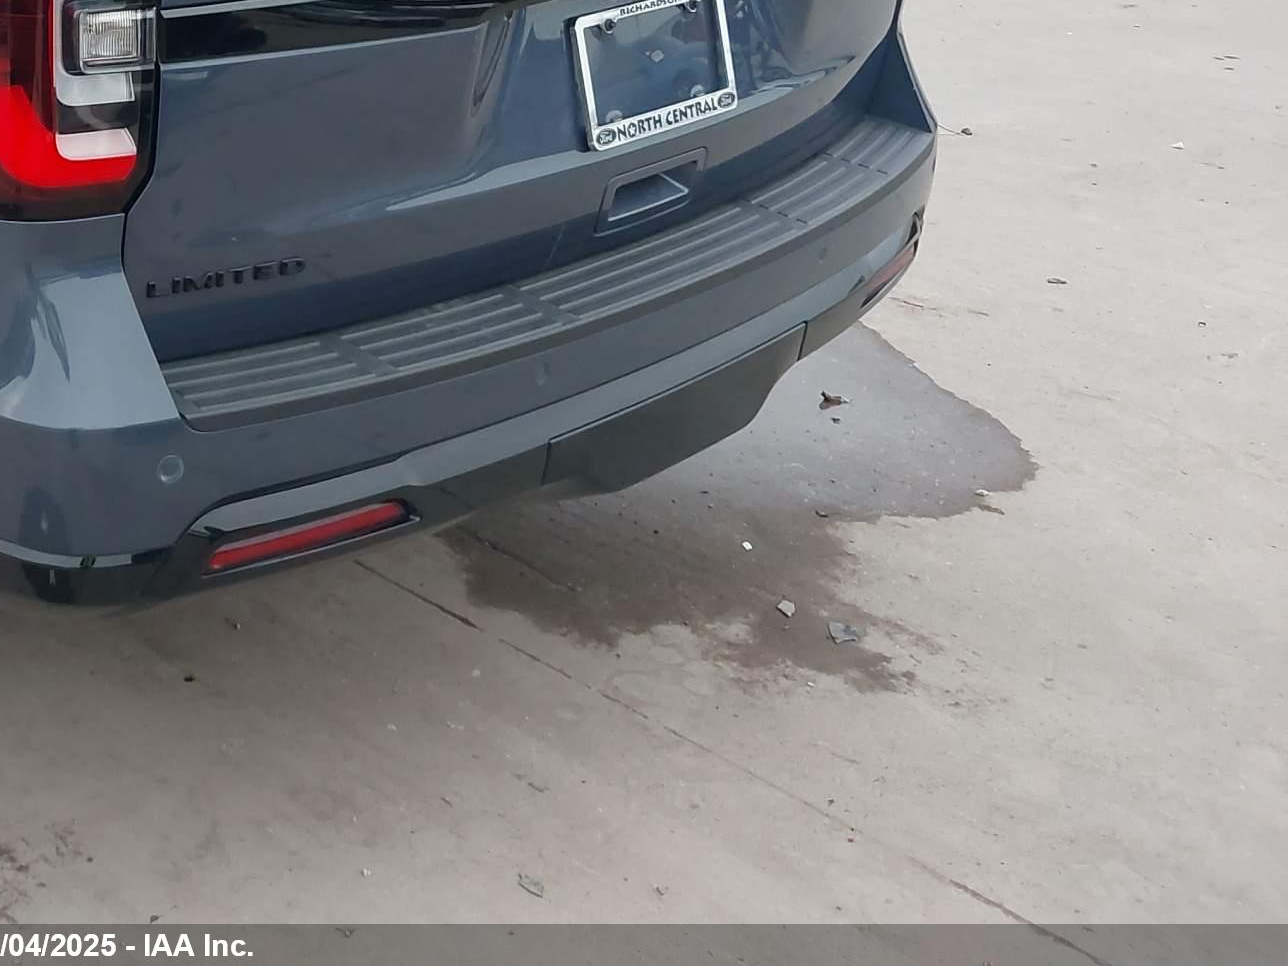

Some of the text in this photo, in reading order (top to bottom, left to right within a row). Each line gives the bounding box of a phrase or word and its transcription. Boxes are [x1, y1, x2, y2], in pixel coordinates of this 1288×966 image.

[616, 98, 718, 142] NORTH CENTRAL
[146, 257, 307, 298] LIMITED
